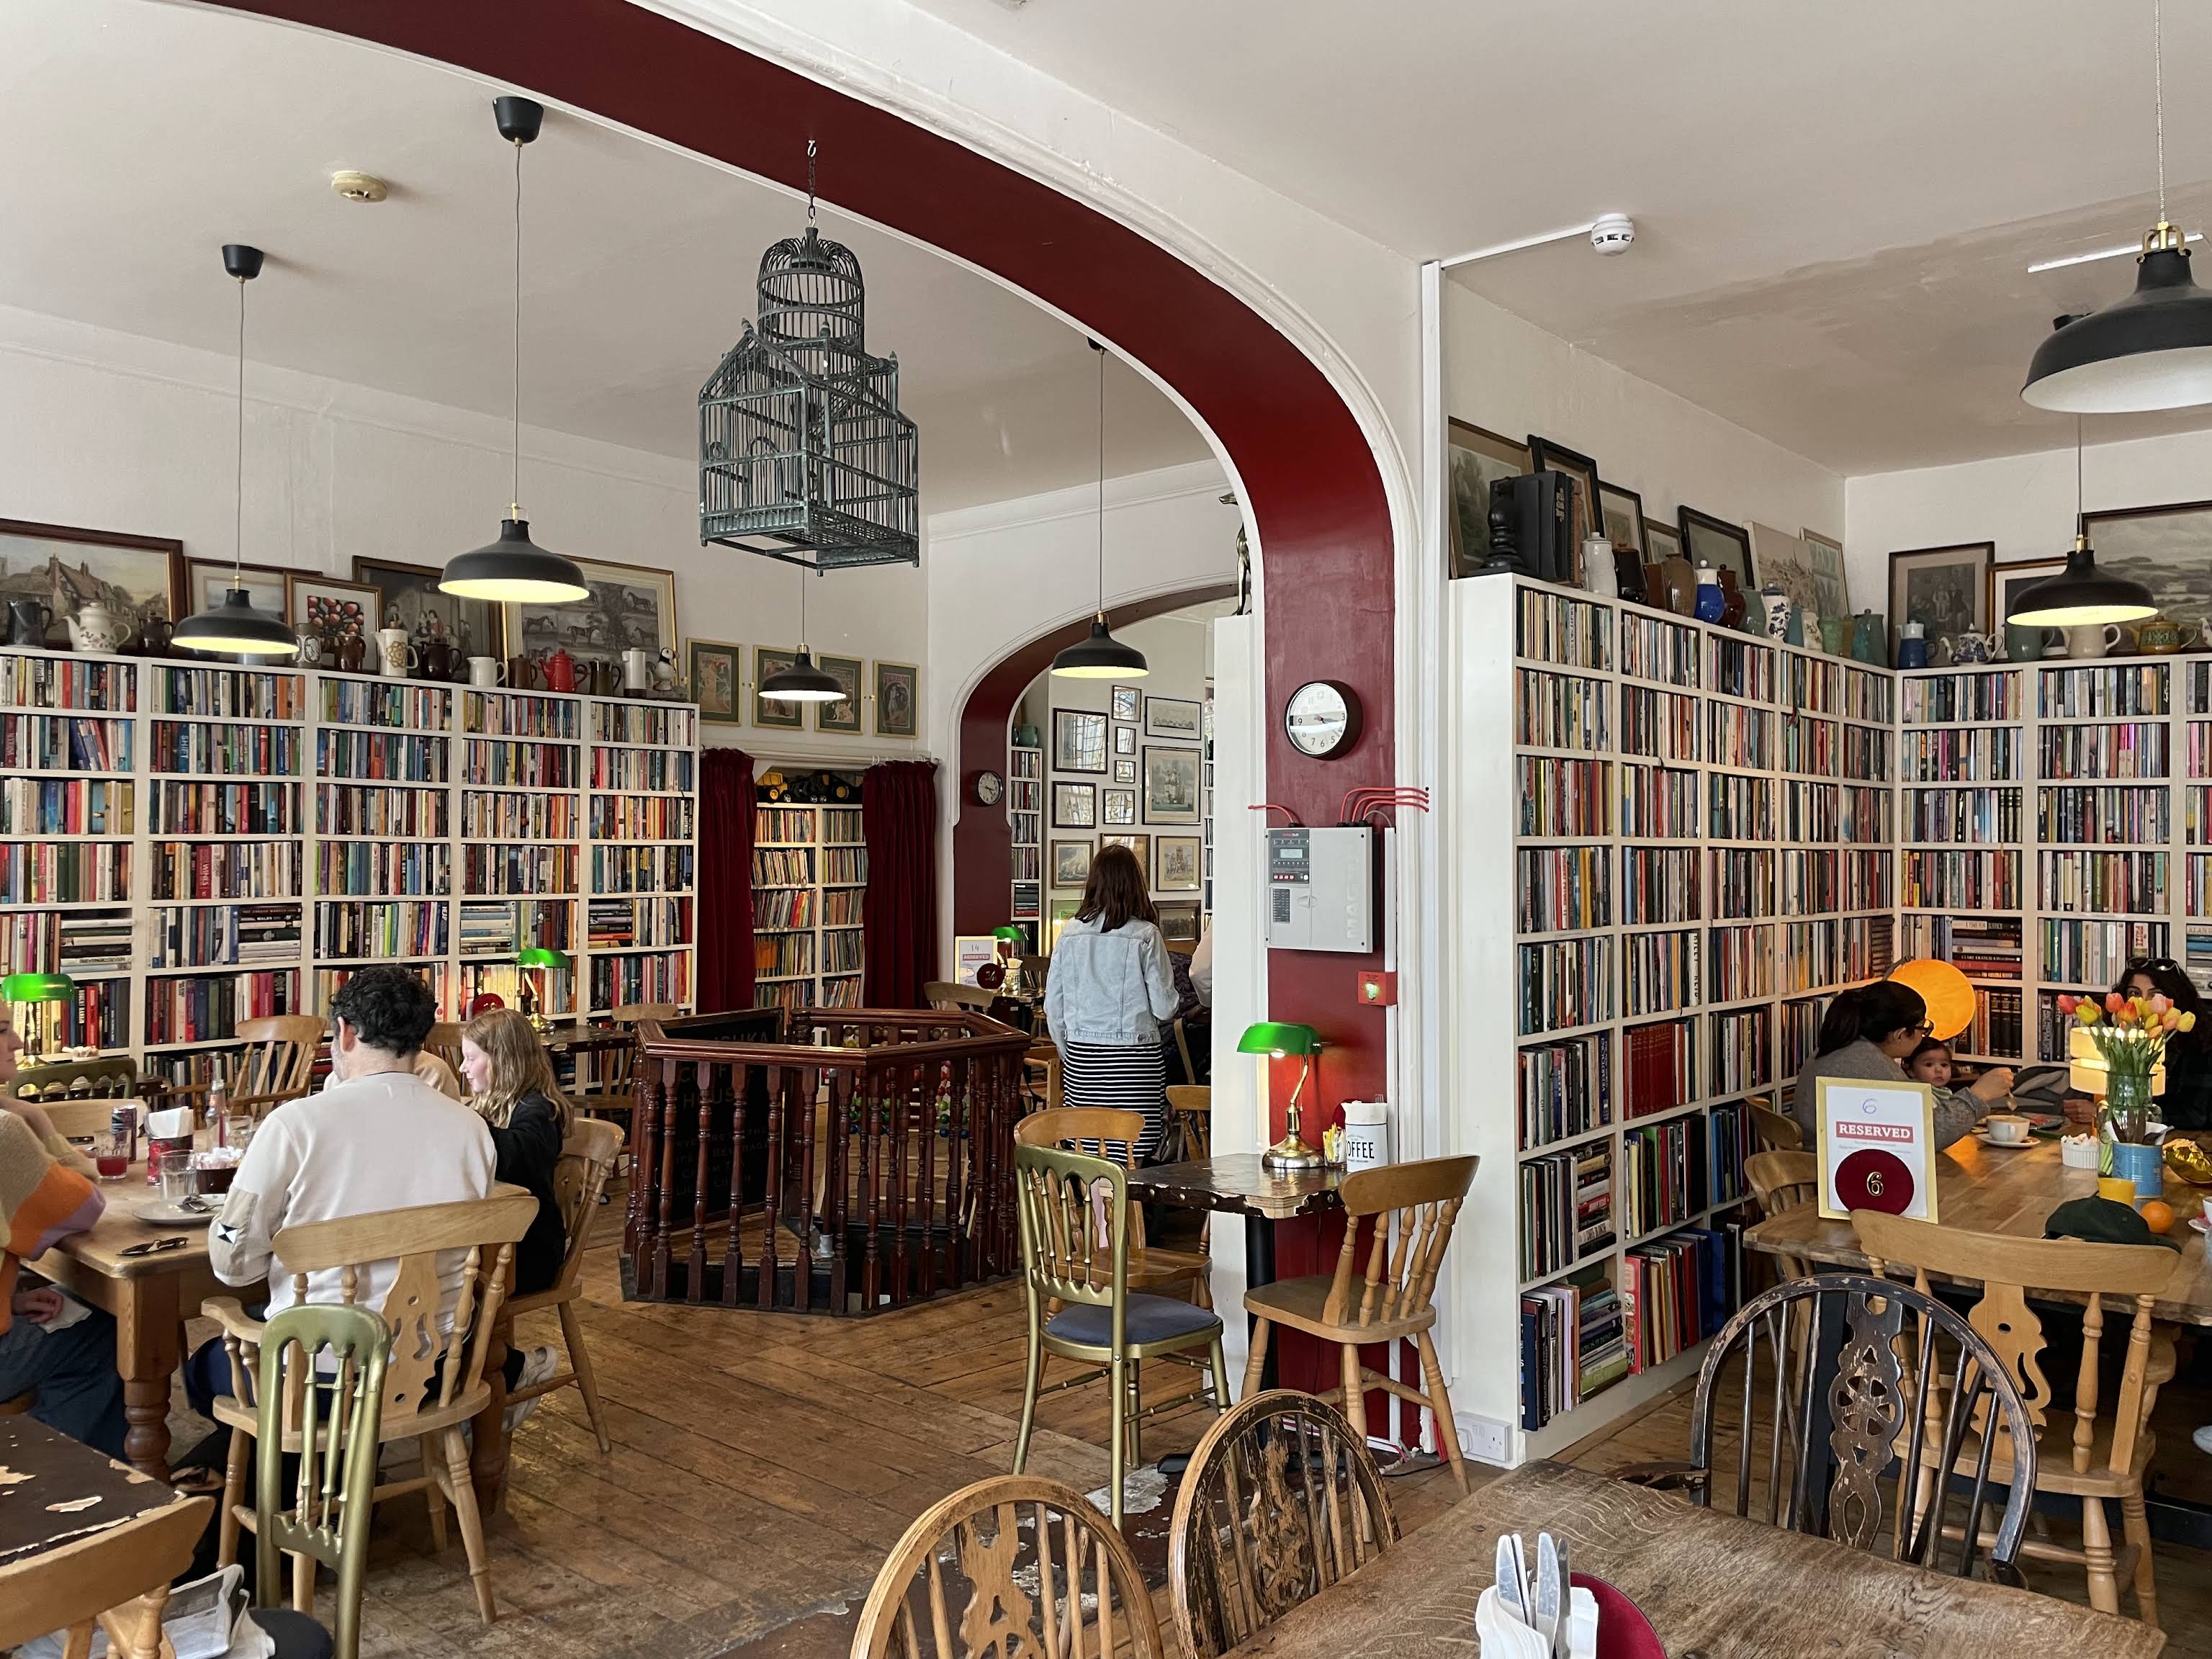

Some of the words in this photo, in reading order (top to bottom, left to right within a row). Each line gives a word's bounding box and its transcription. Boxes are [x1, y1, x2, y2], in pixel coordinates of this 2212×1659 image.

[1863, 1098, 1877, 1114] 6
[1839, 1123, 1910, 1139] RESERVED
[1346, 1141, 1375, 1160] OFFEE
[1866, 1171, 1884, 1197] 6
